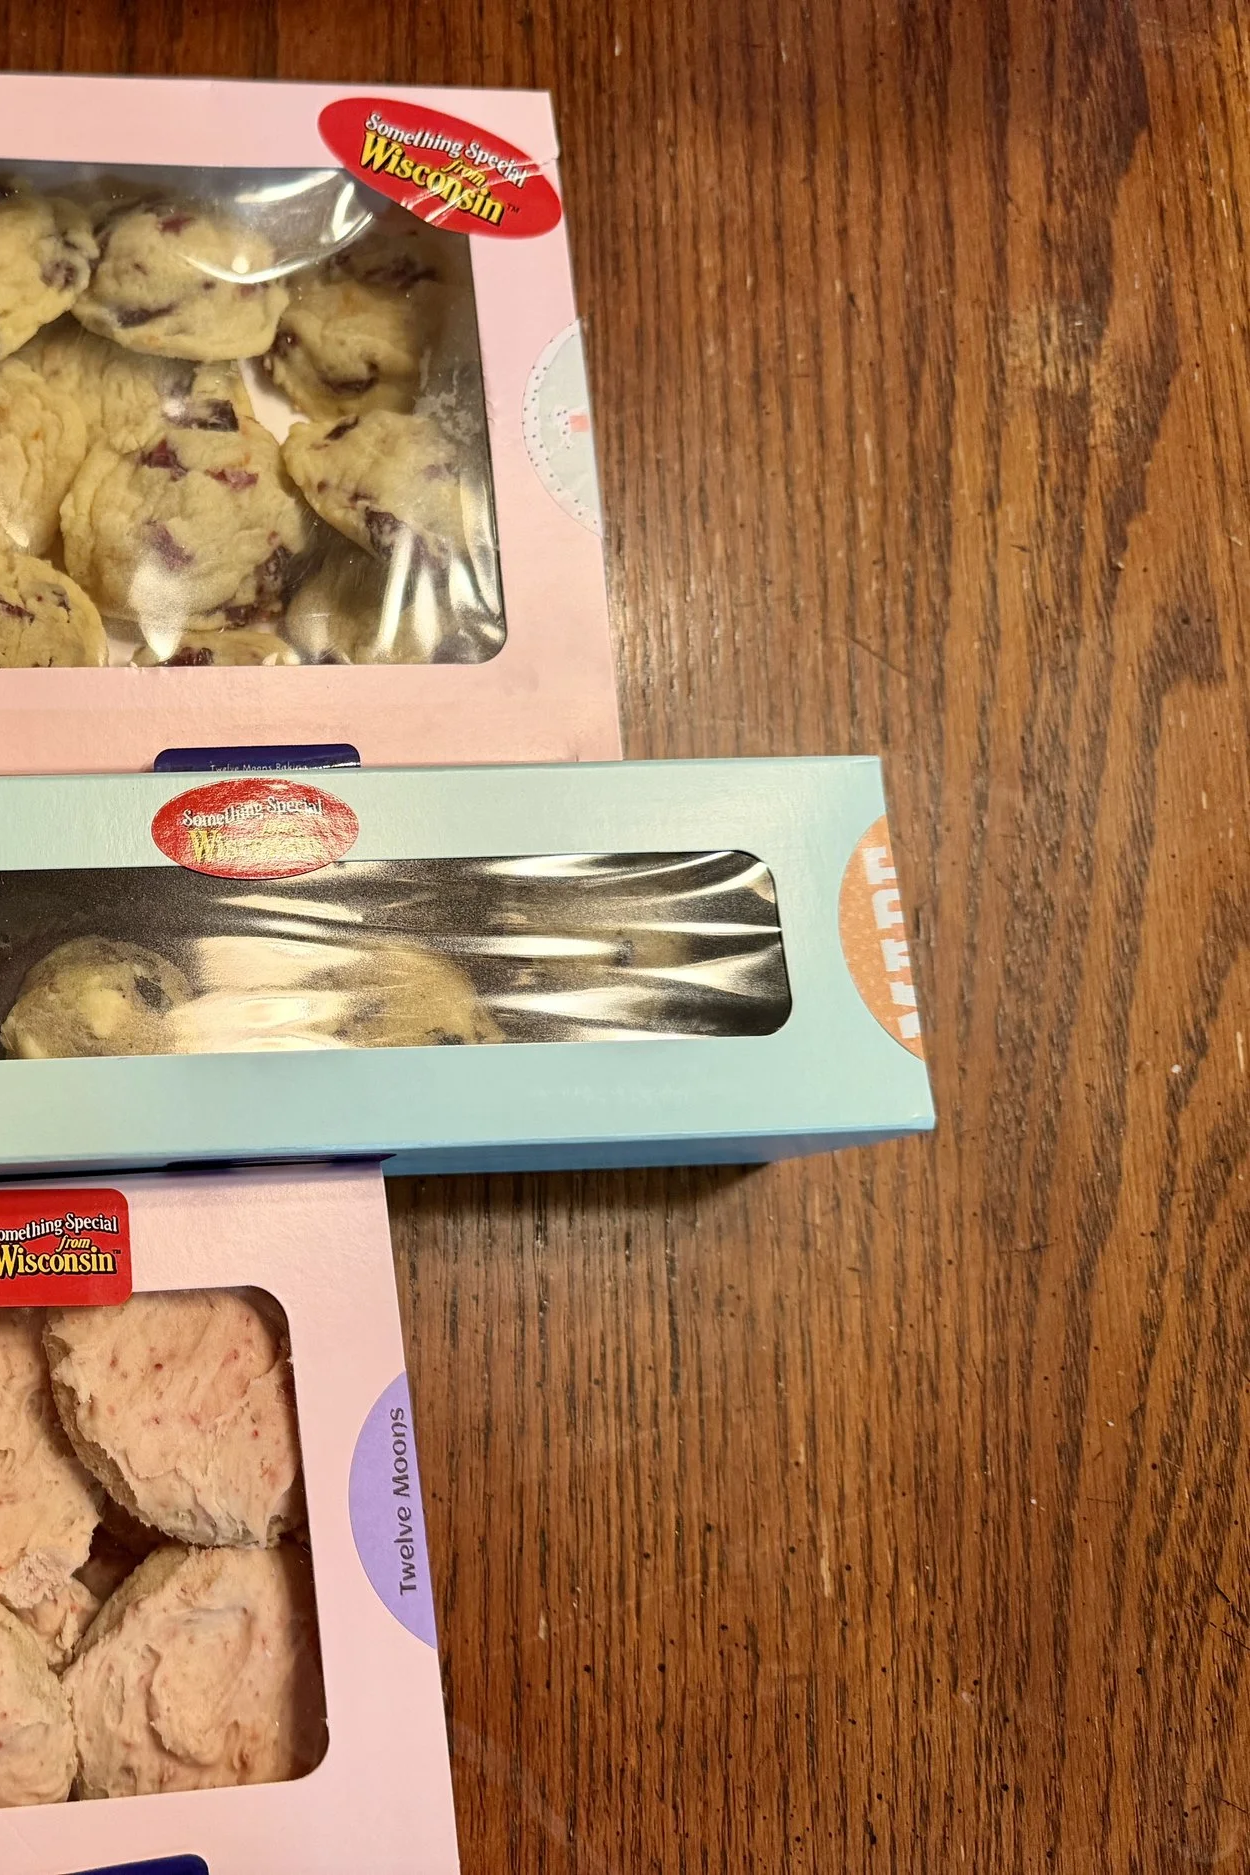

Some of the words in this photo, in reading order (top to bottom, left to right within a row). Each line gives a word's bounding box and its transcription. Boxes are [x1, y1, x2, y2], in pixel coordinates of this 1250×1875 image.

[364, 112, 463, 158] Something
[465, 141, 527, 188] Special
[441, 159, 486, 187] from
[360, 130, 505, 226] Wisconsin
[182, 800, 265, 828] Something
[266, 795, 324, 817] Special
[55, 1234, 91, 1253] from
[65, 1213, 118, 1235] Special
[390, 1407, 411, 1498] Moons
[393, 1505, 417, 1596] Twelve
